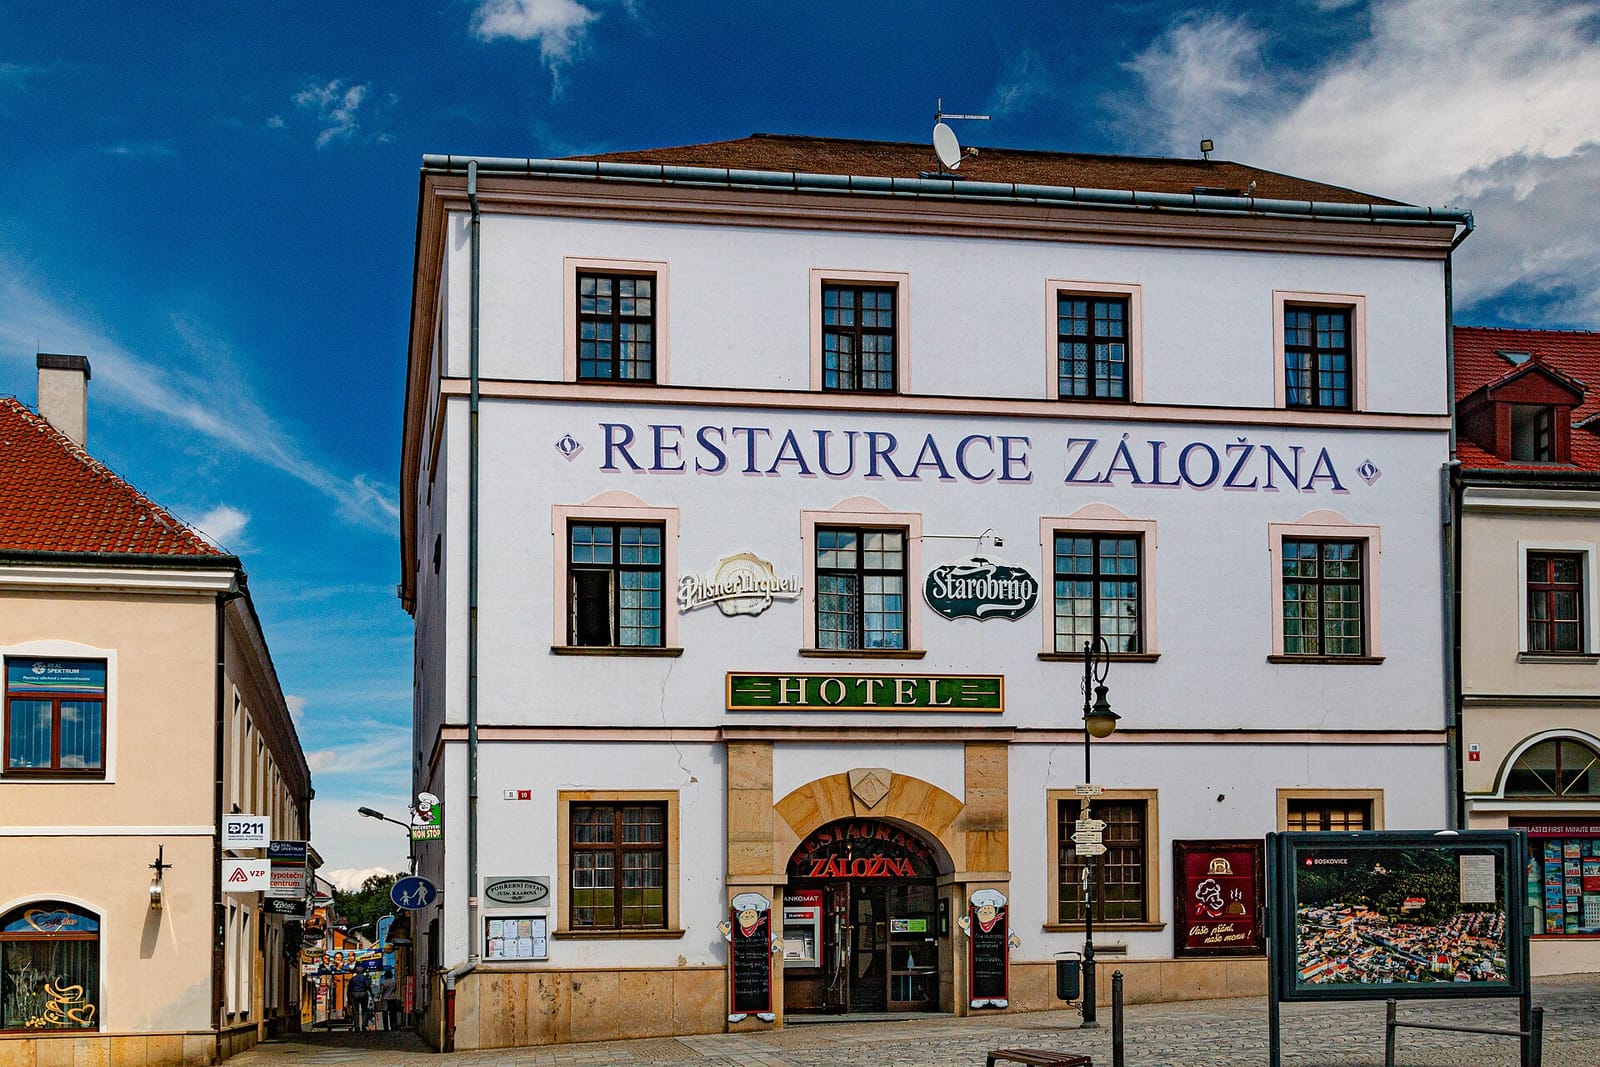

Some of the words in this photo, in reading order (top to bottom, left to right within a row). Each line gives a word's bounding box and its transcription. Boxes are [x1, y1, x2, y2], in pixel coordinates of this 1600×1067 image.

[599, 423, 1032, 481] RESTAURACE
[1065, 433, 1347, 491] ZÁLOŽNA
[679, 574, 740, 609] Pilsner
[738, 570, 800, 601] Urquell
[932, 565, 1033, 605] Starobrno
[778, 678, 952, 705] HOTEL
[242, 823, 264, 834] 211
[412, 830, 426, 839] NON
[427, 829, 441, 838] STOP
[809, 853, 917, 877] ZÁLOŽNA
